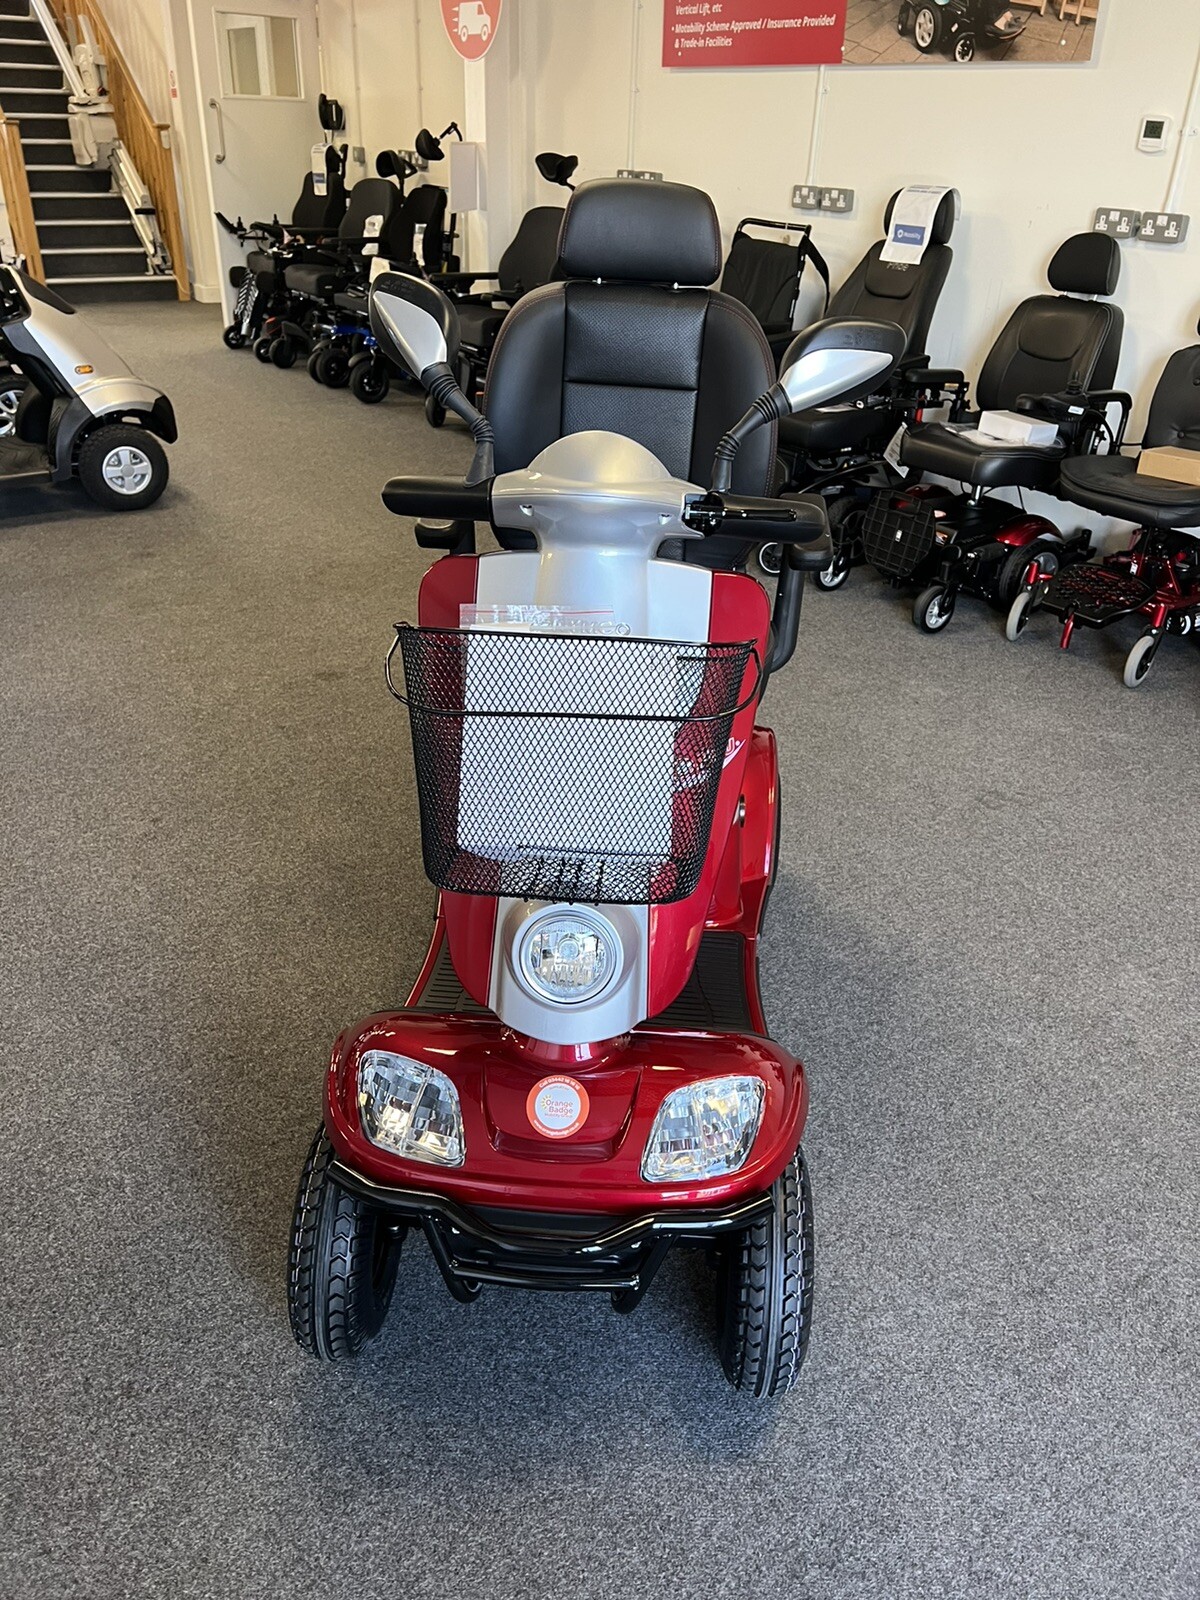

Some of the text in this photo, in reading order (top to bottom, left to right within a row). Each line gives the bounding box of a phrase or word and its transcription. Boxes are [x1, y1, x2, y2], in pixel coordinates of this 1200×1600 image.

[676, 3, 699, 15] Vertical
[712, 4, 722, 13] etc
[675, 22, 705, 35] Motability
[706, 21, 730, 32] Scheme
[730, 18, 762, 33] Approved
[767, 18, 802, 29] Insurance
[802, 13, 836, 27] Provided
[681, 37, 704, 48] Trade-in
[705, 35, 732, 47] Facilities
[545, 1099, 573, 1108] Orange
[548, 1106, 573, 1115] Badge
